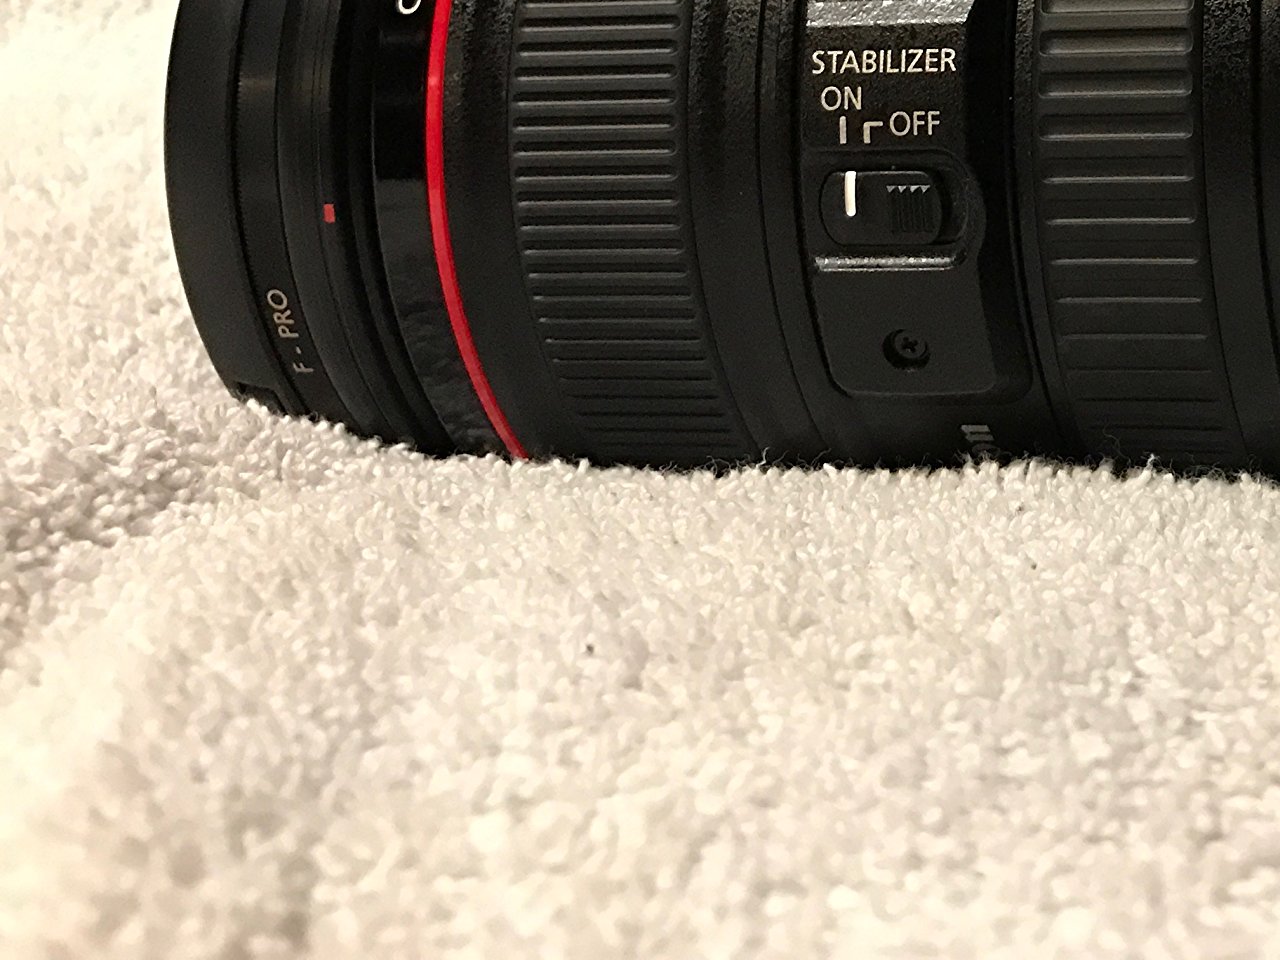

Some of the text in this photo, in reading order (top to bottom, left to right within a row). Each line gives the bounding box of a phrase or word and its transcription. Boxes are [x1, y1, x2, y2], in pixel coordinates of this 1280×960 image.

[810, 47, 957, 76] STABILIZER
[820, 85, 863, 112] ON
[889, 110, 941, 137] OFF
